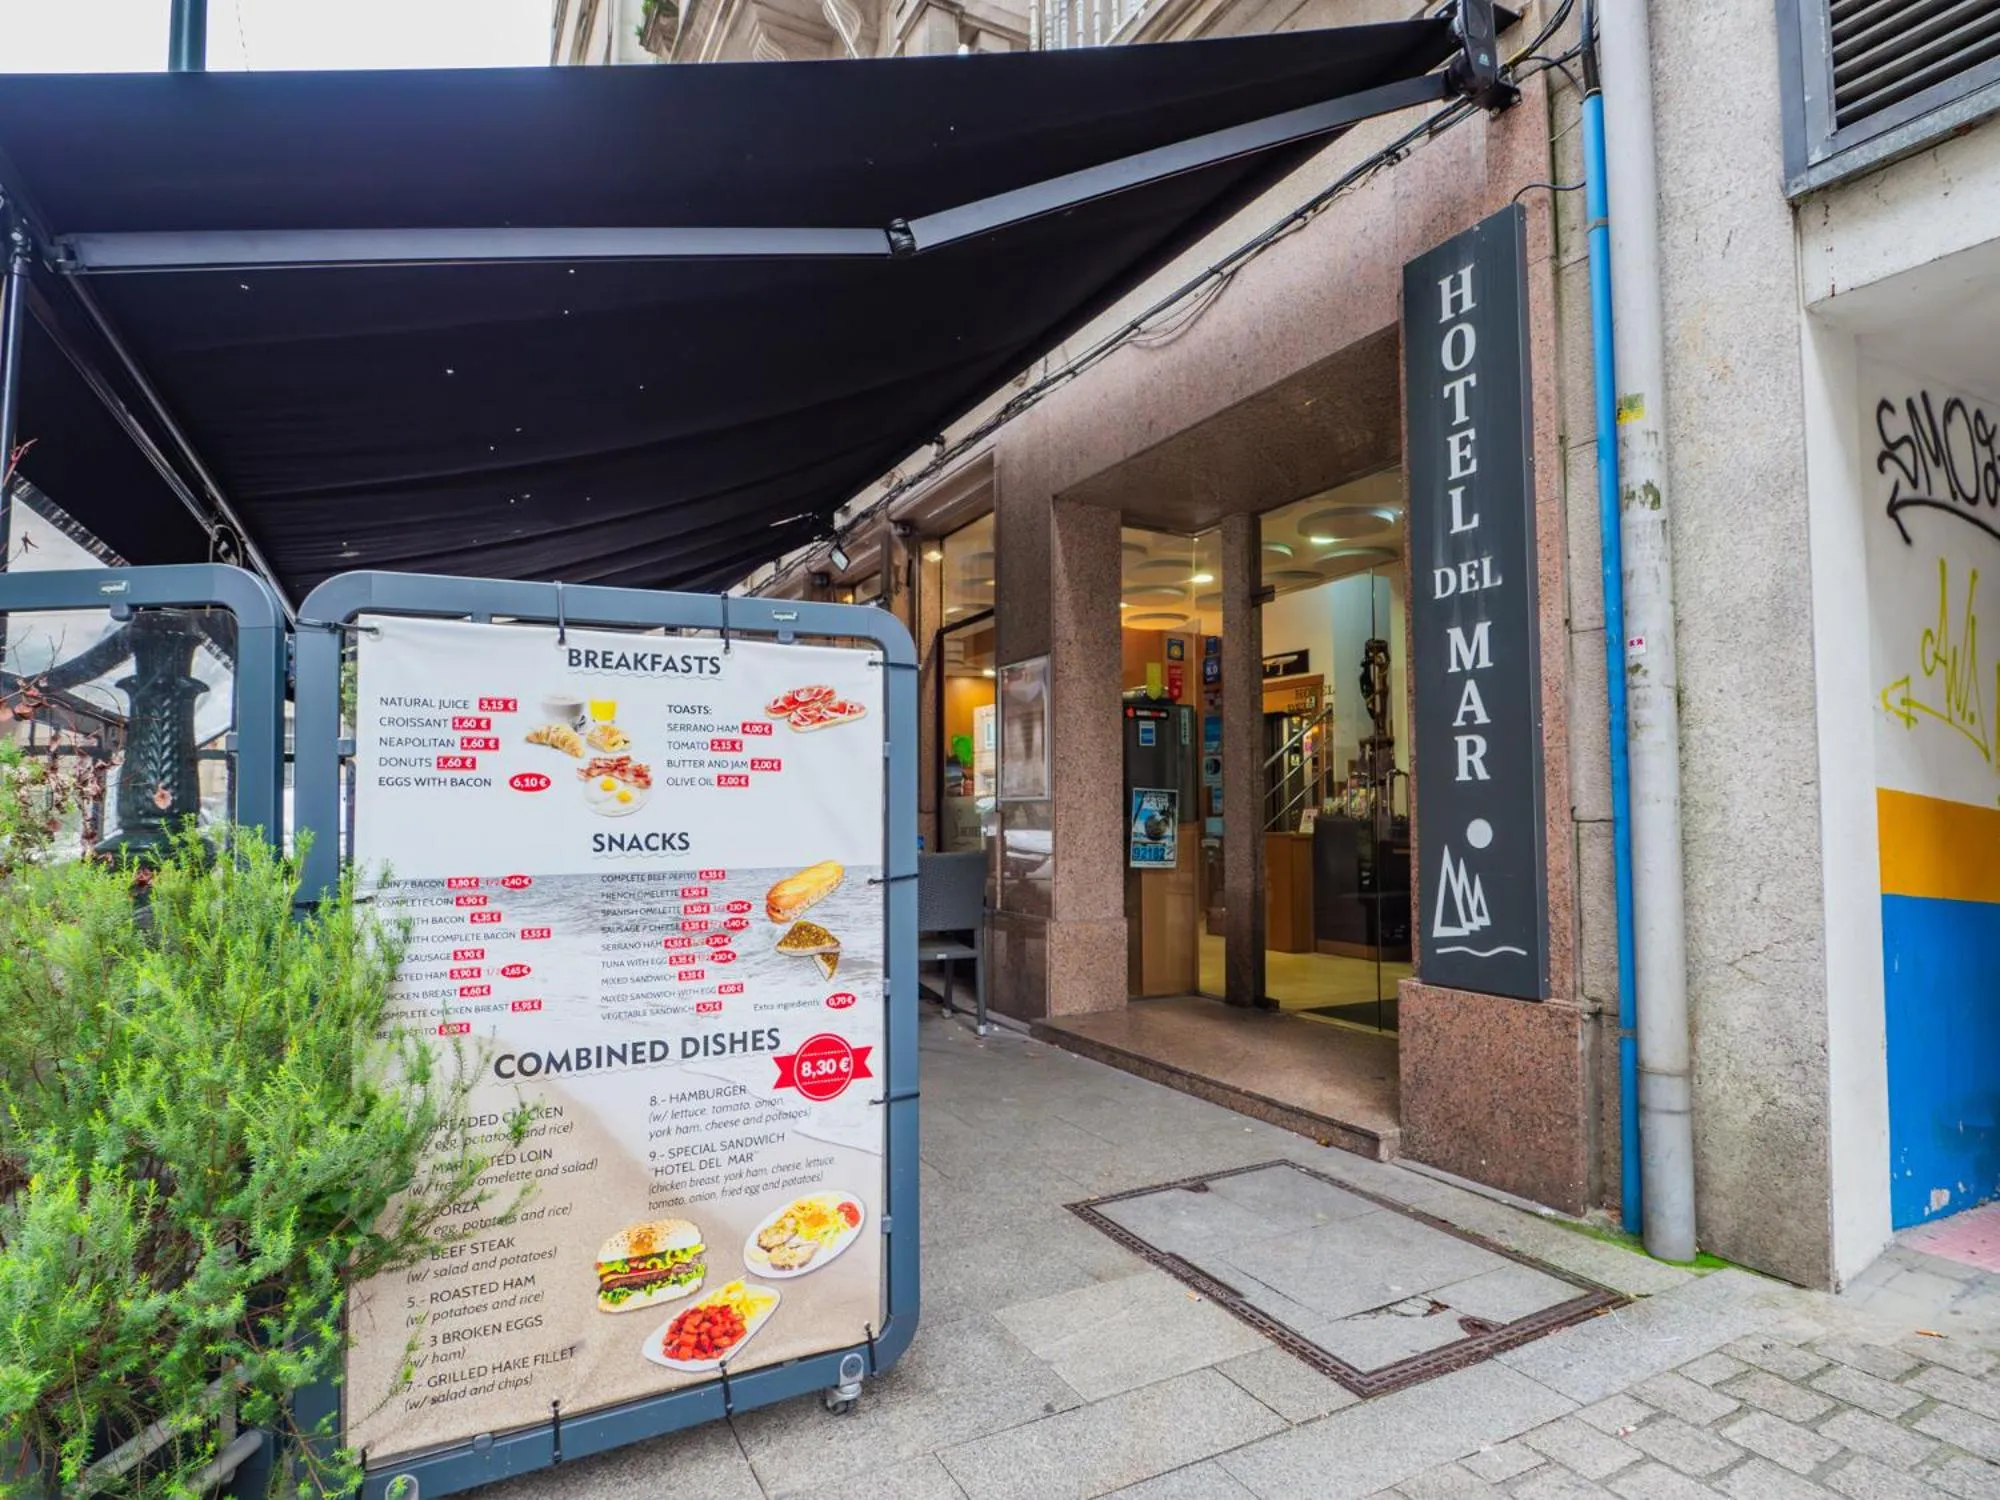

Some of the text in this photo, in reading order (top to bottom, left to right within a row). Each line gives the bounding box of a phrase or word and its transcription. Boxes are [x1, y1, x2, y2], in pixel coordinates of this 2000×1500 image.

[1433, 262, 1503, 781] HOTEL DEL MAR
[568, 648, 721, 675] BREAKFASTS
[380, 697, 435, 708] NATURAL
[438, 699, 470, 710] JUICE
[667, 704, 713, 715] TOASTS:
[379, 716, 448, 728] CROISSANT
[454, 718, 477, 729] 1,60
[667, 723, 714, 734] SERRANO
[717, 724, 739, 734] HAM
[379, 736, 455, 748] NEAPOLITAN
[462, 738, 485, 748] 1,60
[667, 740, 709, 751] TOMATO
[378, 756, 432, 768] DONUTS
[438, 758, 461, 768] 1,60
[667, 759, 705, 769] BUTTER
[707, 759, 729, 769] AND
[730, 759, 748, 770] JAM
[378, 776, 411, 787] EGGS
[414, 777, 447, 787] WITH
[450, 777, 492, 788] BACON
[666, 777, 696, 787] OLIVE
[698, 777, 715, 787] OIL
[592, 832, 690, 853] SNACKS
[410, 880, 445, 889] BACON
[431, 916, 464, 925] BACON
[431, 932, 480, 943] COMPLETE
[483, 931, 515, 941] BACON
[601, 941, 641, 951] SERRANO
[407, 953, 451, 964] SAUSAGE
[601, 960, 625, 969] TUNA
[626, 959, 649, 968] WITH
[425, 971, 448, 980] HAM
[601, 974, 676, 986] MIXED SANDWICH
[422, 989, 458, 999] BREAST
[601, 993, 628, 1003] MIXED
[629, 990, 676, 1000] SANDWICH
[430, 1005, 472, 1017] CHICKEN
[474, 1004, 509, 1013] BREAST
[601, 1006, 695, 1021] VEGETABLE SANDWICH
[753, 1003, 774, 1011] Extra
[494, 1027, 781, 1079] COMBINED DISHES
[801, 1056, 850, 1079] 8,30 €
[669, 1084, 747, 1104] HAMBURGER
[649, 1110, 668, 1124] (w/
[523, 1120, 574, 1137] and rice)
[649, 1126, 672, 1141] york
[705, 1118, 741, 1131] cheese
[742, 1113, 764, 1126] and
[668, 1142, 717, 1160] SPECIAL
[720, 1132, 786, 1152] SANDWICH
[520, 1148, 554, 1161] LOIN
[698, 1158, 723, 1170] DEL
[477, 1169, 533, 1187] omelette
[535, 1163, 558, 1178] and
[561, 1157, 599, 1174] salad)
[648, 1180, 688, 1196] (chicken
[723, 1169, 744, 1184] york
[721, 1186, 743, 1199] fried
[744, 1184, 761, 1198] egg
[762, 1179, 780, 1191] and
[520, 1209, 545, 1222] and
[548, 1202, 573, 1218] rice)
[470, 1236, 516, 1254] STEAK
[406, 1246, 558, 1285] (w/ salad and potatoes)
[430, 1282, 499, 1305] ROASTED
[503, 1275, 536, 1291] HAM
[431, 1303, 488, 1326] potatoes
[492, 1297, 516, 1311] and
[520, 1290, 545, 1306] rice)
[442, 1325, 502, 1345] BROKEN
[505, 1314, 544, 1332] EGGS
[431, 1346, 466, 1364] ham)
[427, 1345, 577, 1388] GRILLED HAKE FILLET
[404, 1373, 534, 1413] (w/ salad and chips)
